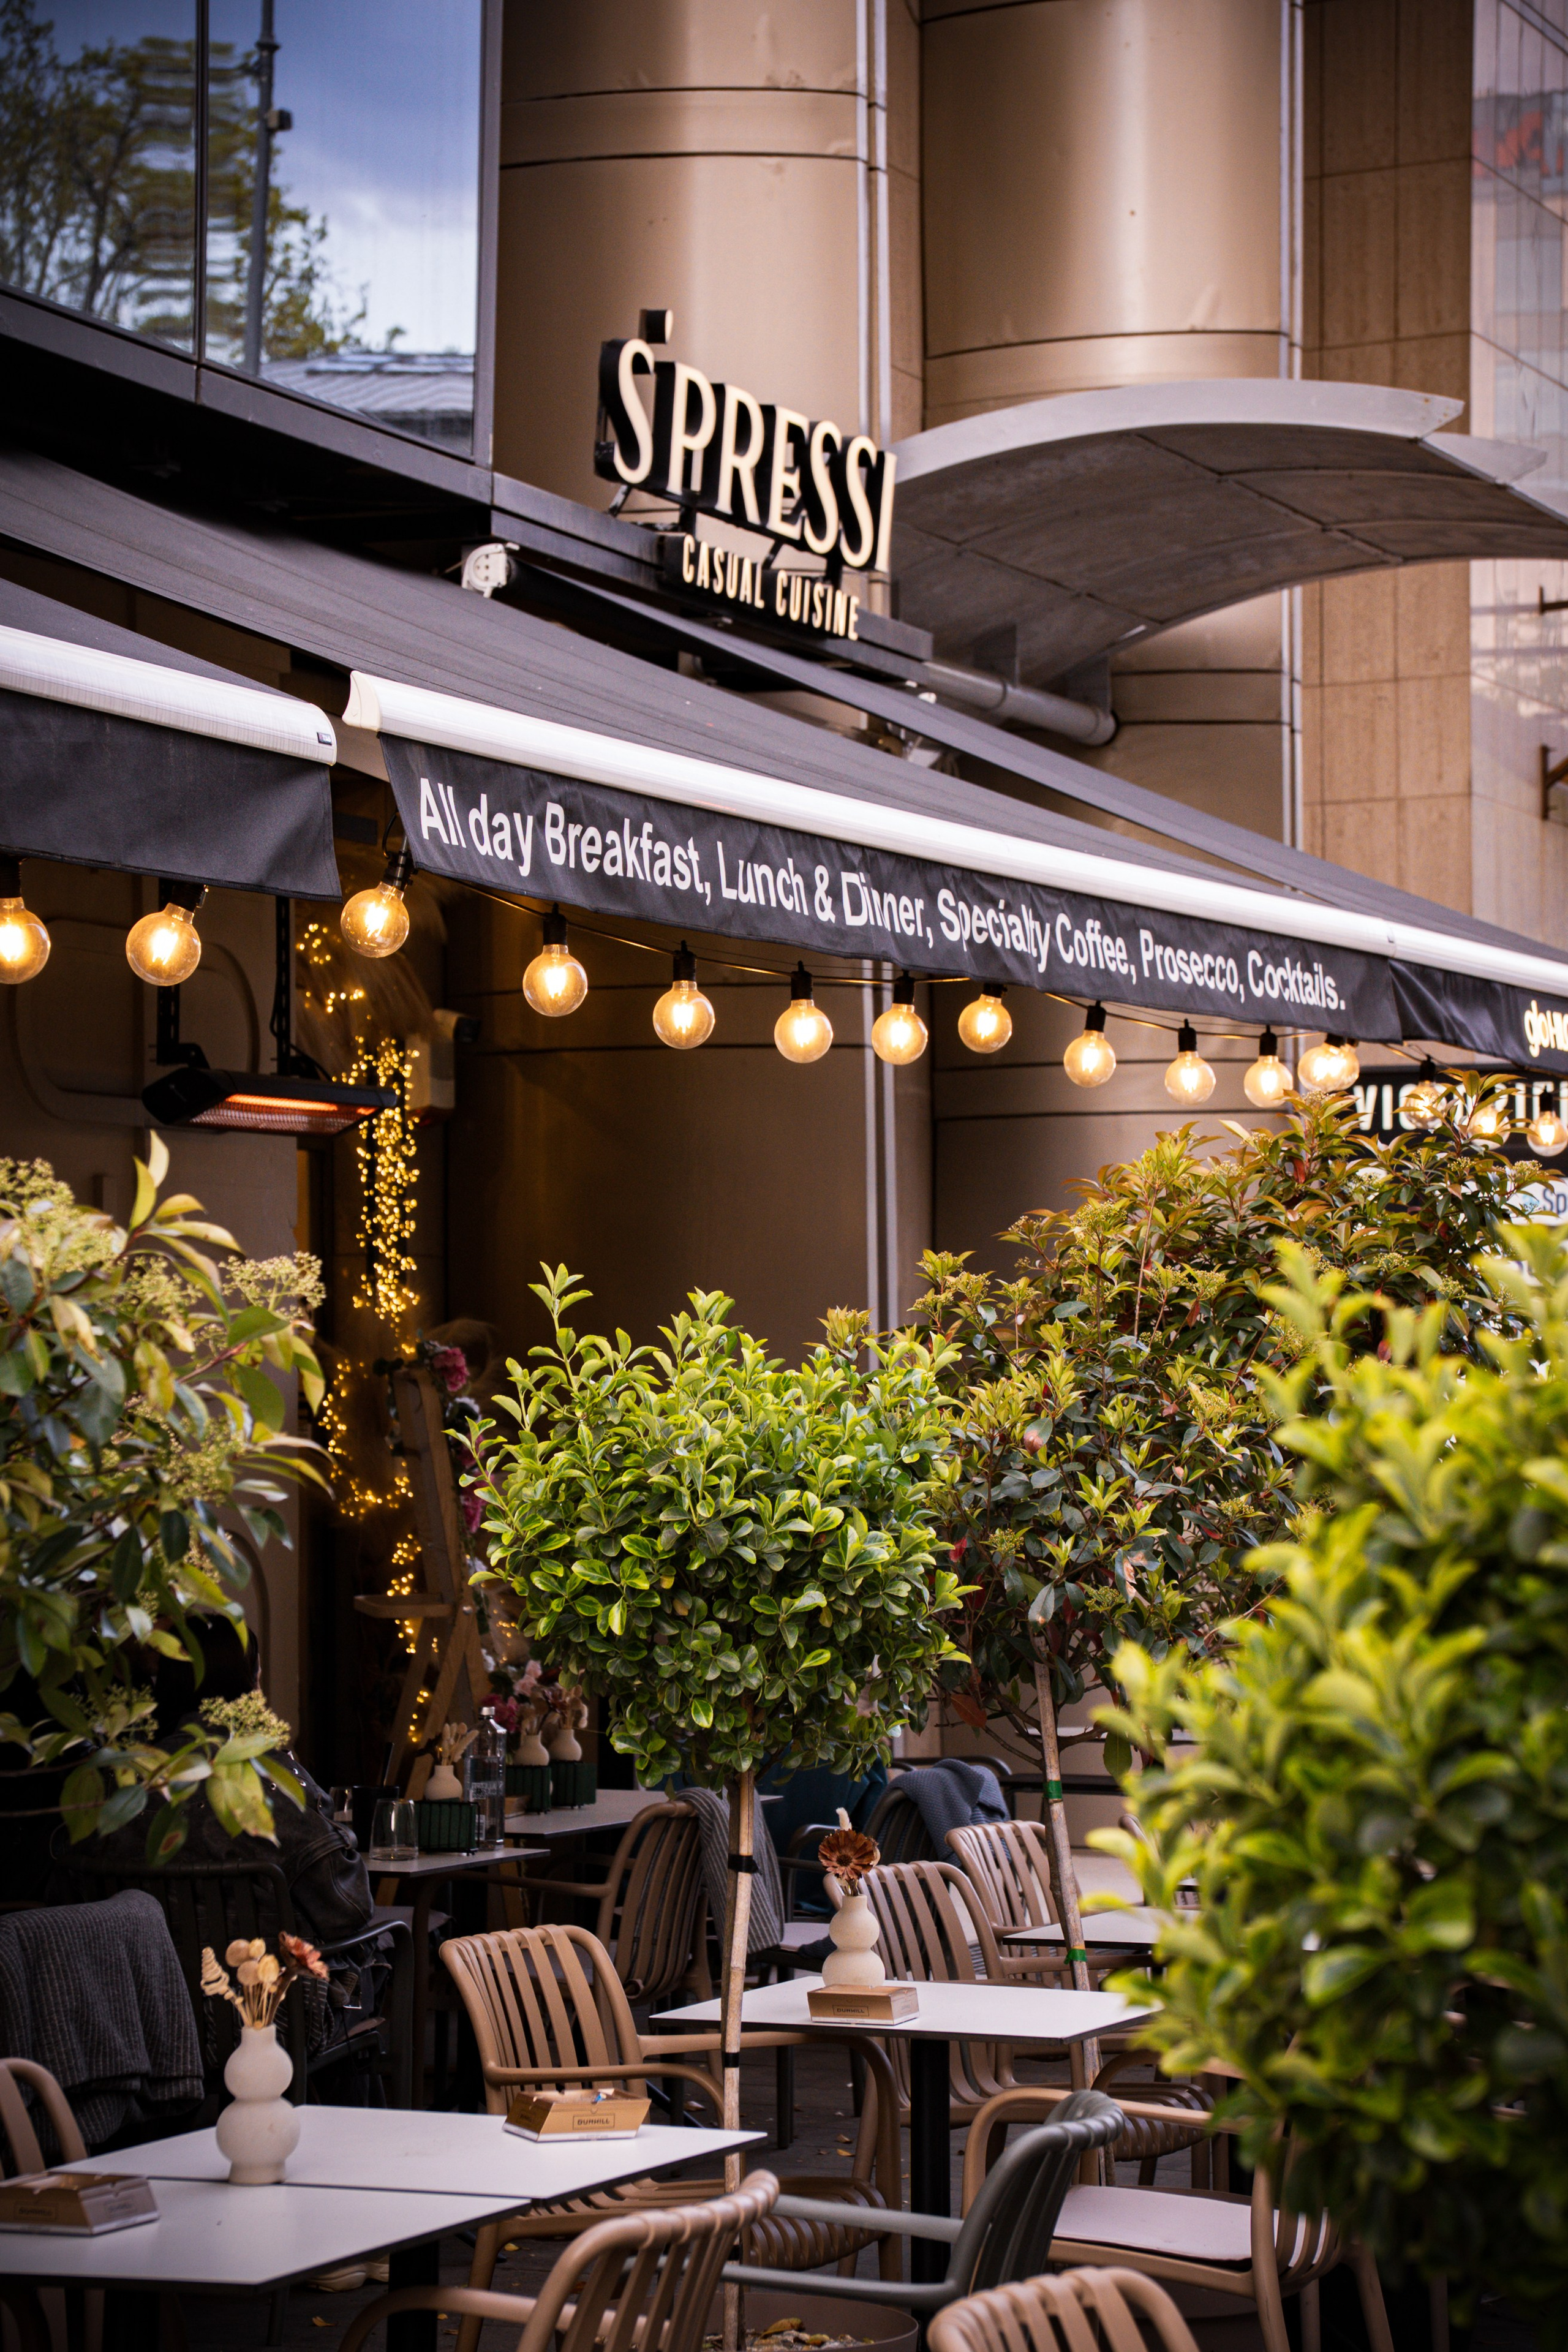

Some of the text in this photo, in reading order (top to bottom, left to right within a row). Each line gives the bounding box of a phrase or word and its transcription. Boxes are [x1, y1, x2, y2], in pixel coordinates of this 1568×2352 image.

[682, 533, 861, 641] CASUAL CUISINE
[420, 777, 1347, 1011] All day Breakfast, Lunch & Dinner, Specialty Coffee, Prosecco, Cocktails.
